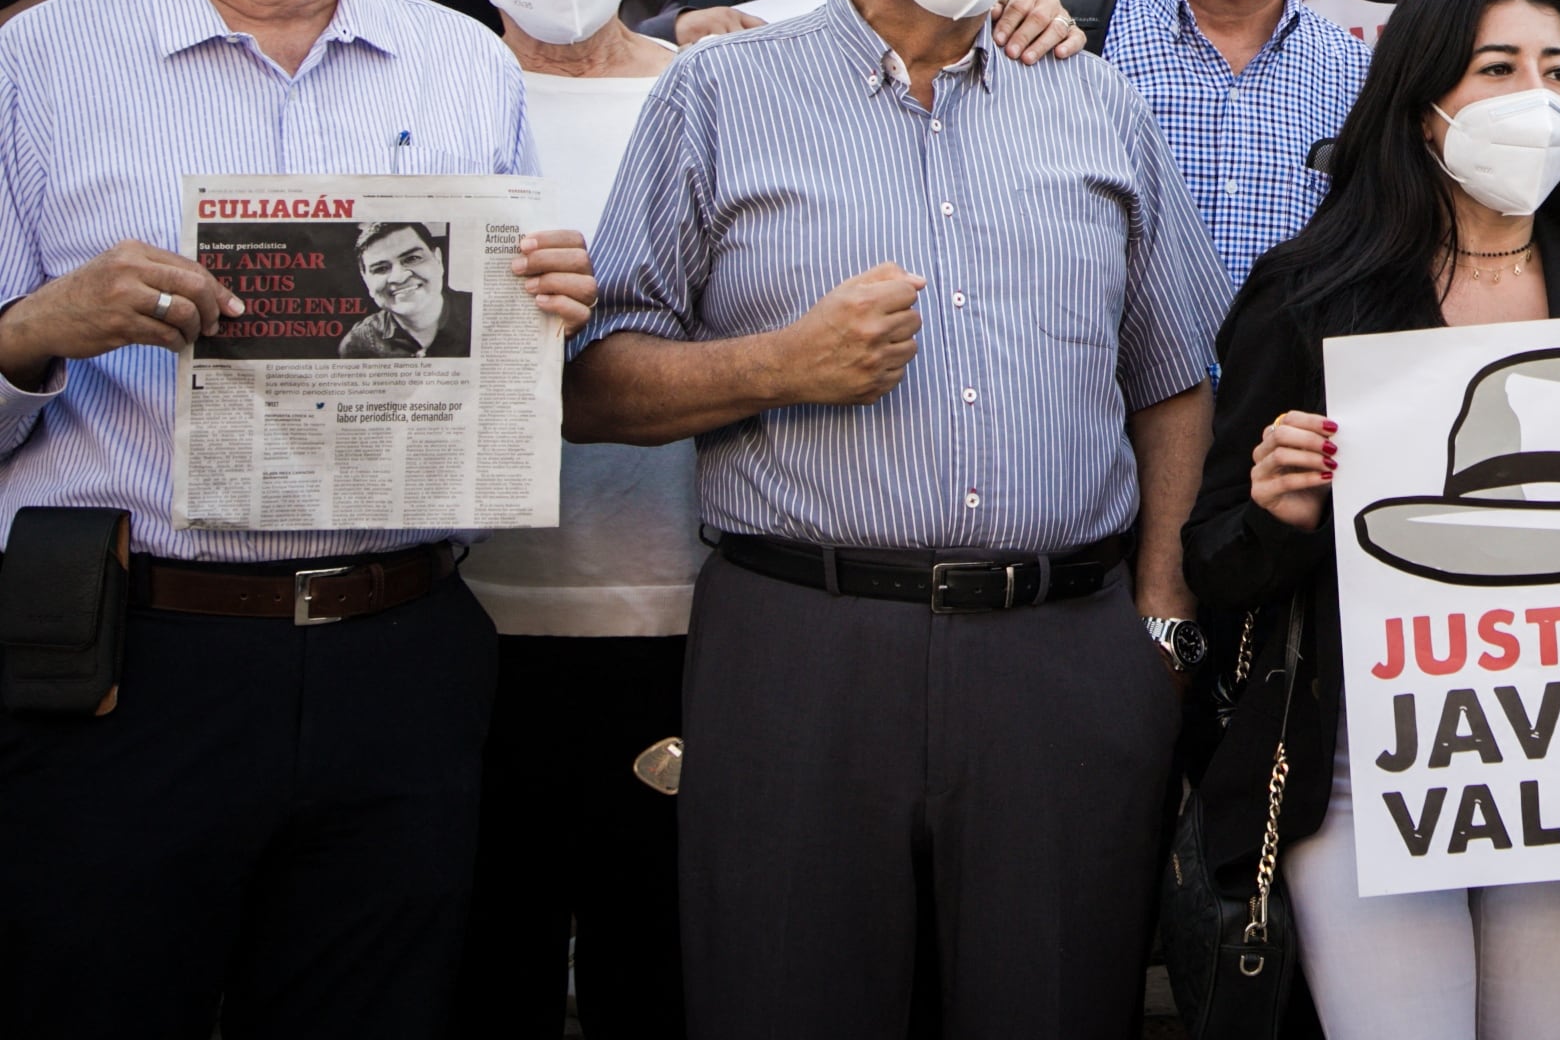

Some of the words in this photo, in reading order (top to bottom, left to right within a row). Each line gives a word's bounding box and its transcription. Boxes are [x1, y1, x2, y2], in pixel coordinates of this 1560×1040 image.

[197, 194, 355, 219] CULIACÁN
[485, 223, 519, 233] Condena
[212, 242, 234, 250] labor
[485, 245, 521, 254] asesinato
[201, 253, 230, 270] EL
[236, 252, 326, 269] ANDAR
[239, 276, 295, 292] LUIS
[304, 298, 335, 314] EN
[339, 298, 368, 314] EL
[215, 321, 344, 337] ERIODISMO
[192, 373, 204, 390] L
[337, 402, 353, 414] Que
[355, 403, 364, 412] se
[366, 401, 408, 414] investigue
[409, 402, 446, 412] asesinato
[448, 402, 463, 414] por
[337, 412, 357, 423] labor
[411, 411, 454, 422] demandan
